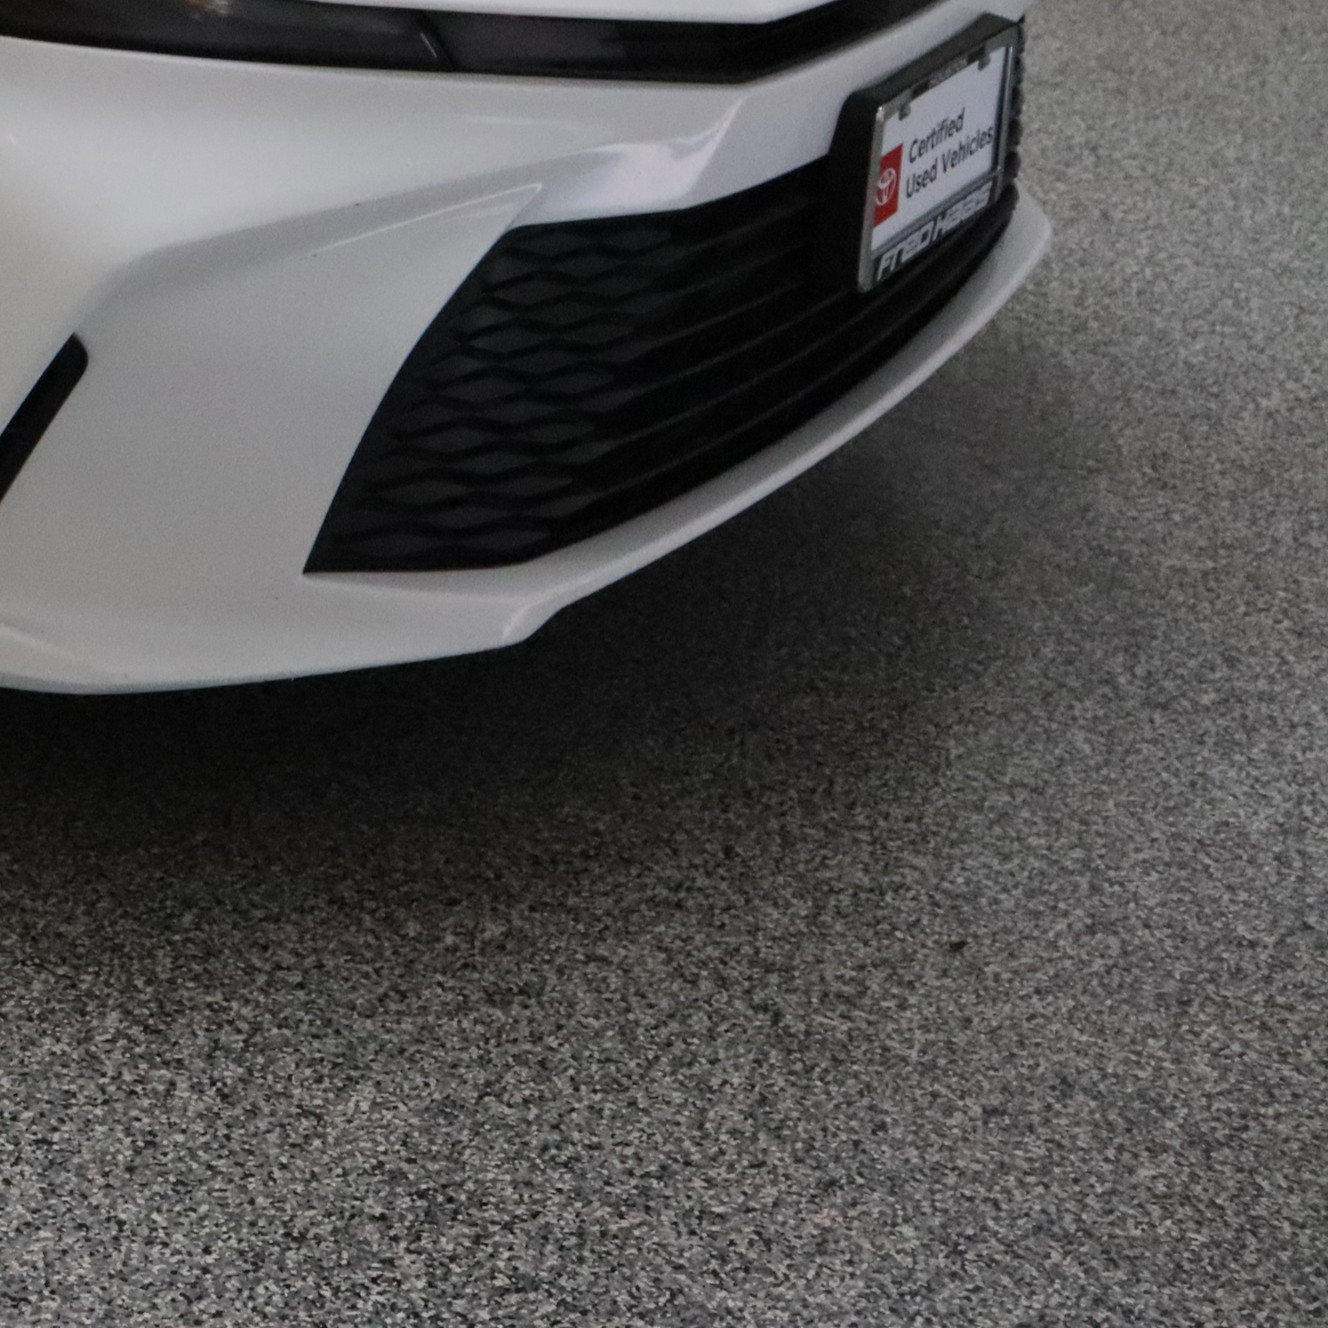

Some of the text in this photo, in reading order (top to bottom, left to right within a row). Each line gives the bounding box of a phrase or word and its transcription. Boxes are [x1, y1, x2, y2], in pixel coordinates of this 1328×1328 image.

[905, 125, 994, 199] Used Vehicles
[908, 105, 966, 164] Certified
